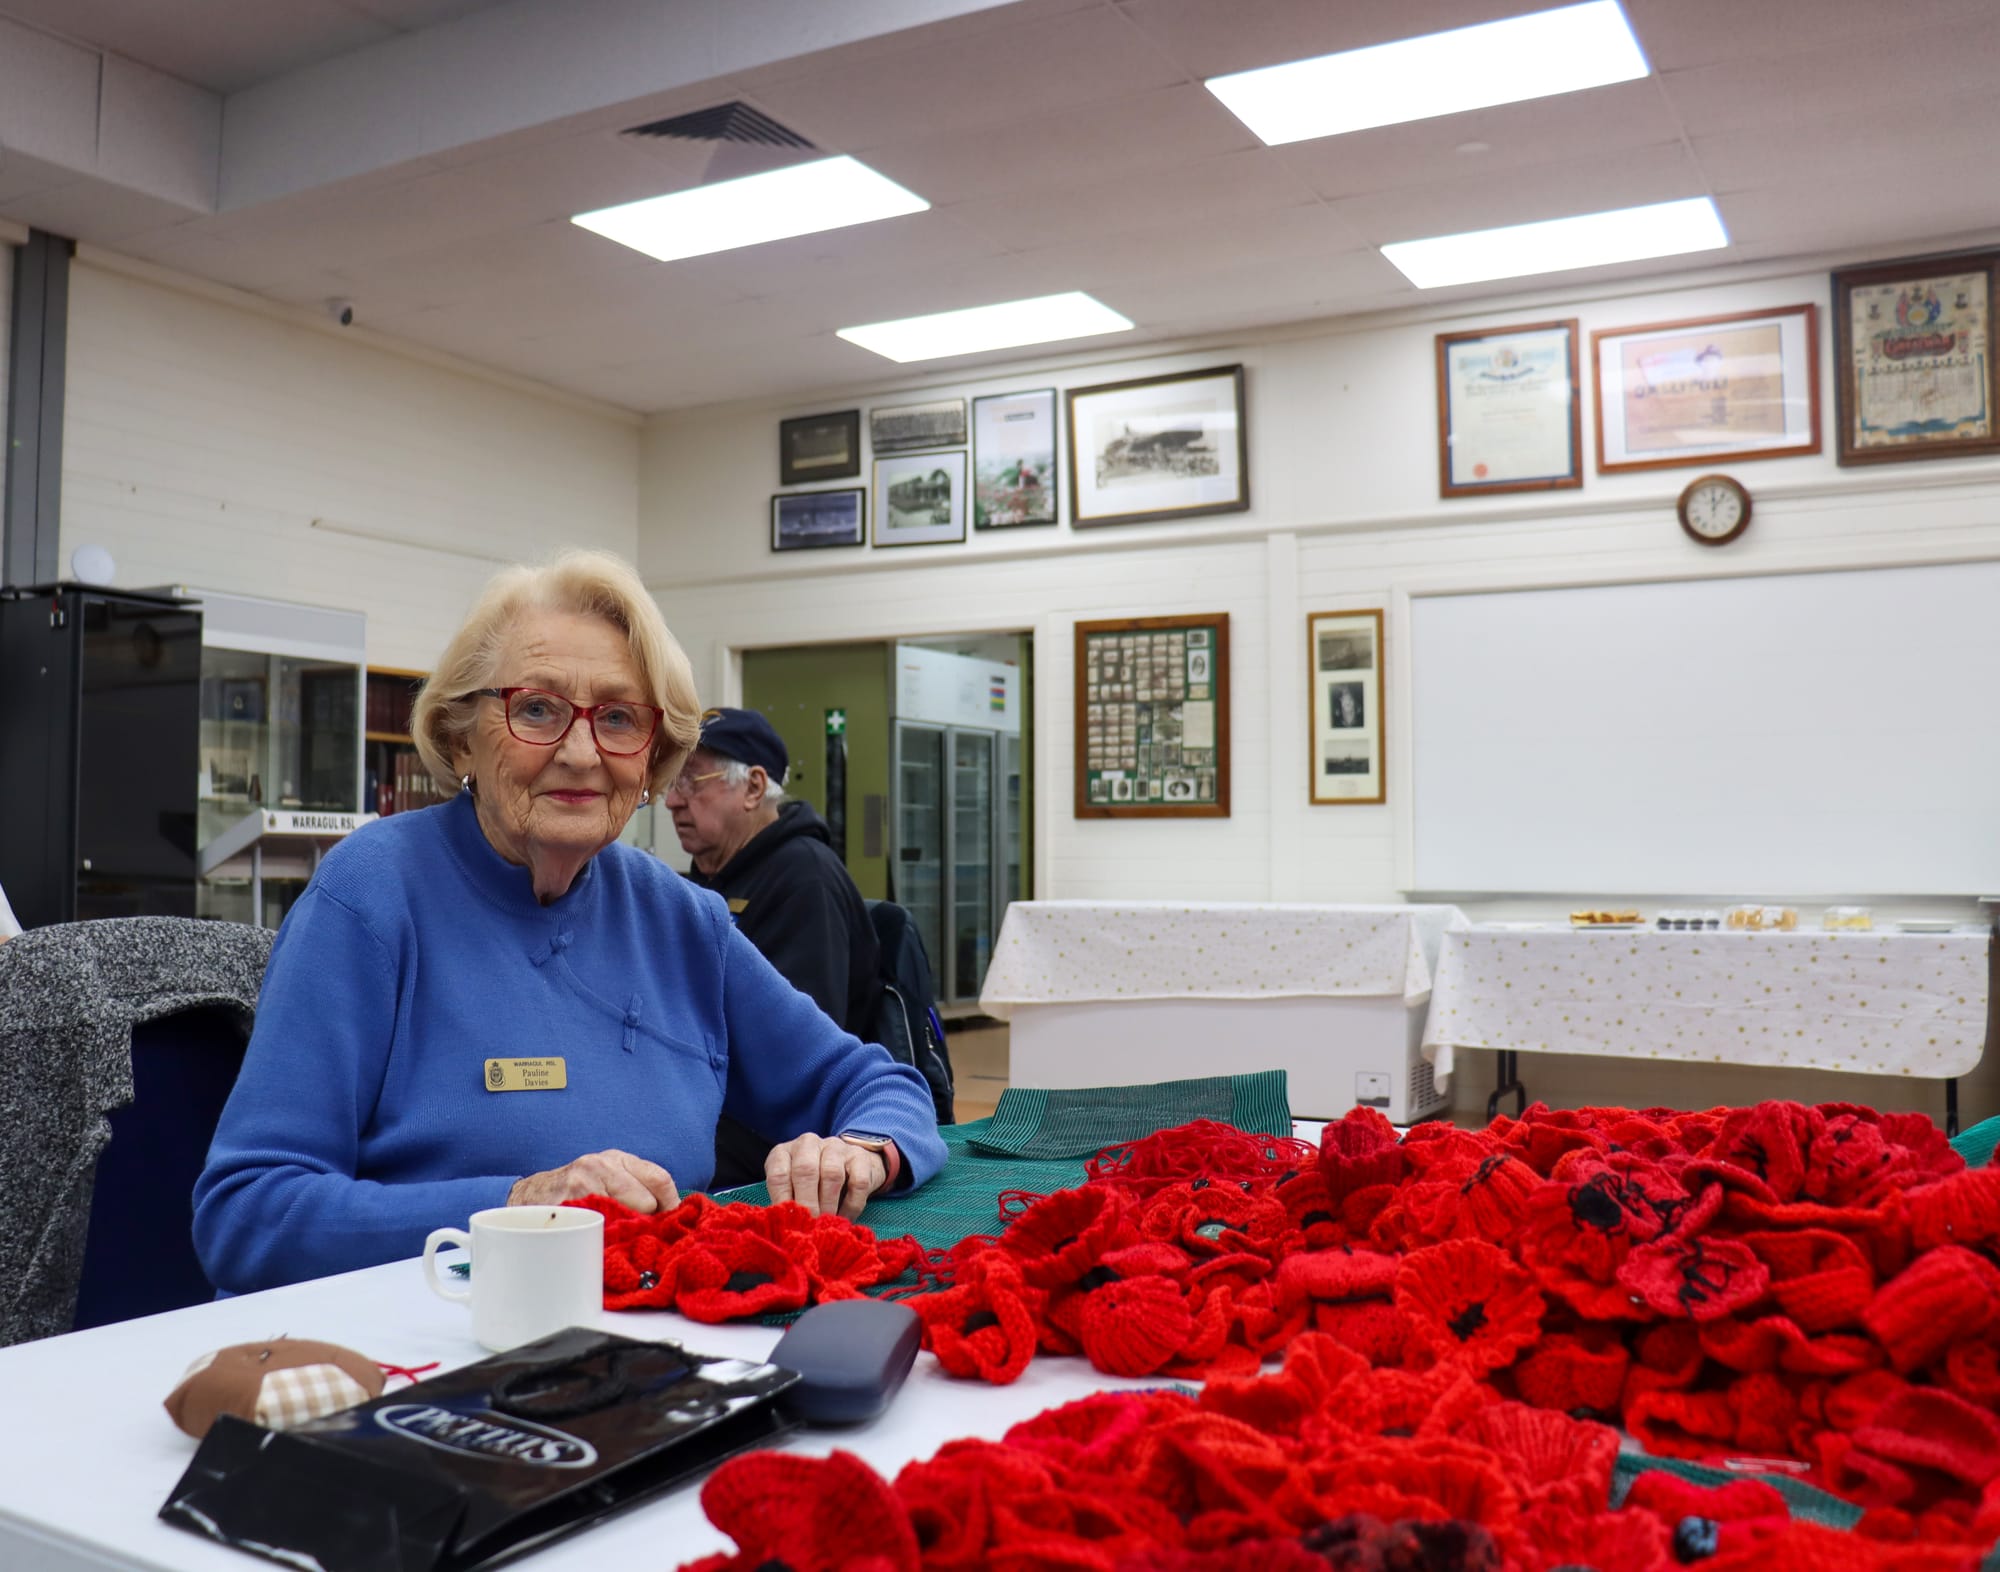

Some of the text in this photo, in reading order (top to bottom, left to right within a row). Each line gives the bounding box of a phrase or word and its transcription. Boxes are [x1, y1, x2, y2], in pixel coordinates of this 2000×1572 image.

[292, 815, 355, 830] WARRAGUL RSL
[522, 1069, 549, 1077] Pauline
[524, 1079, 549, 1087] Davies
